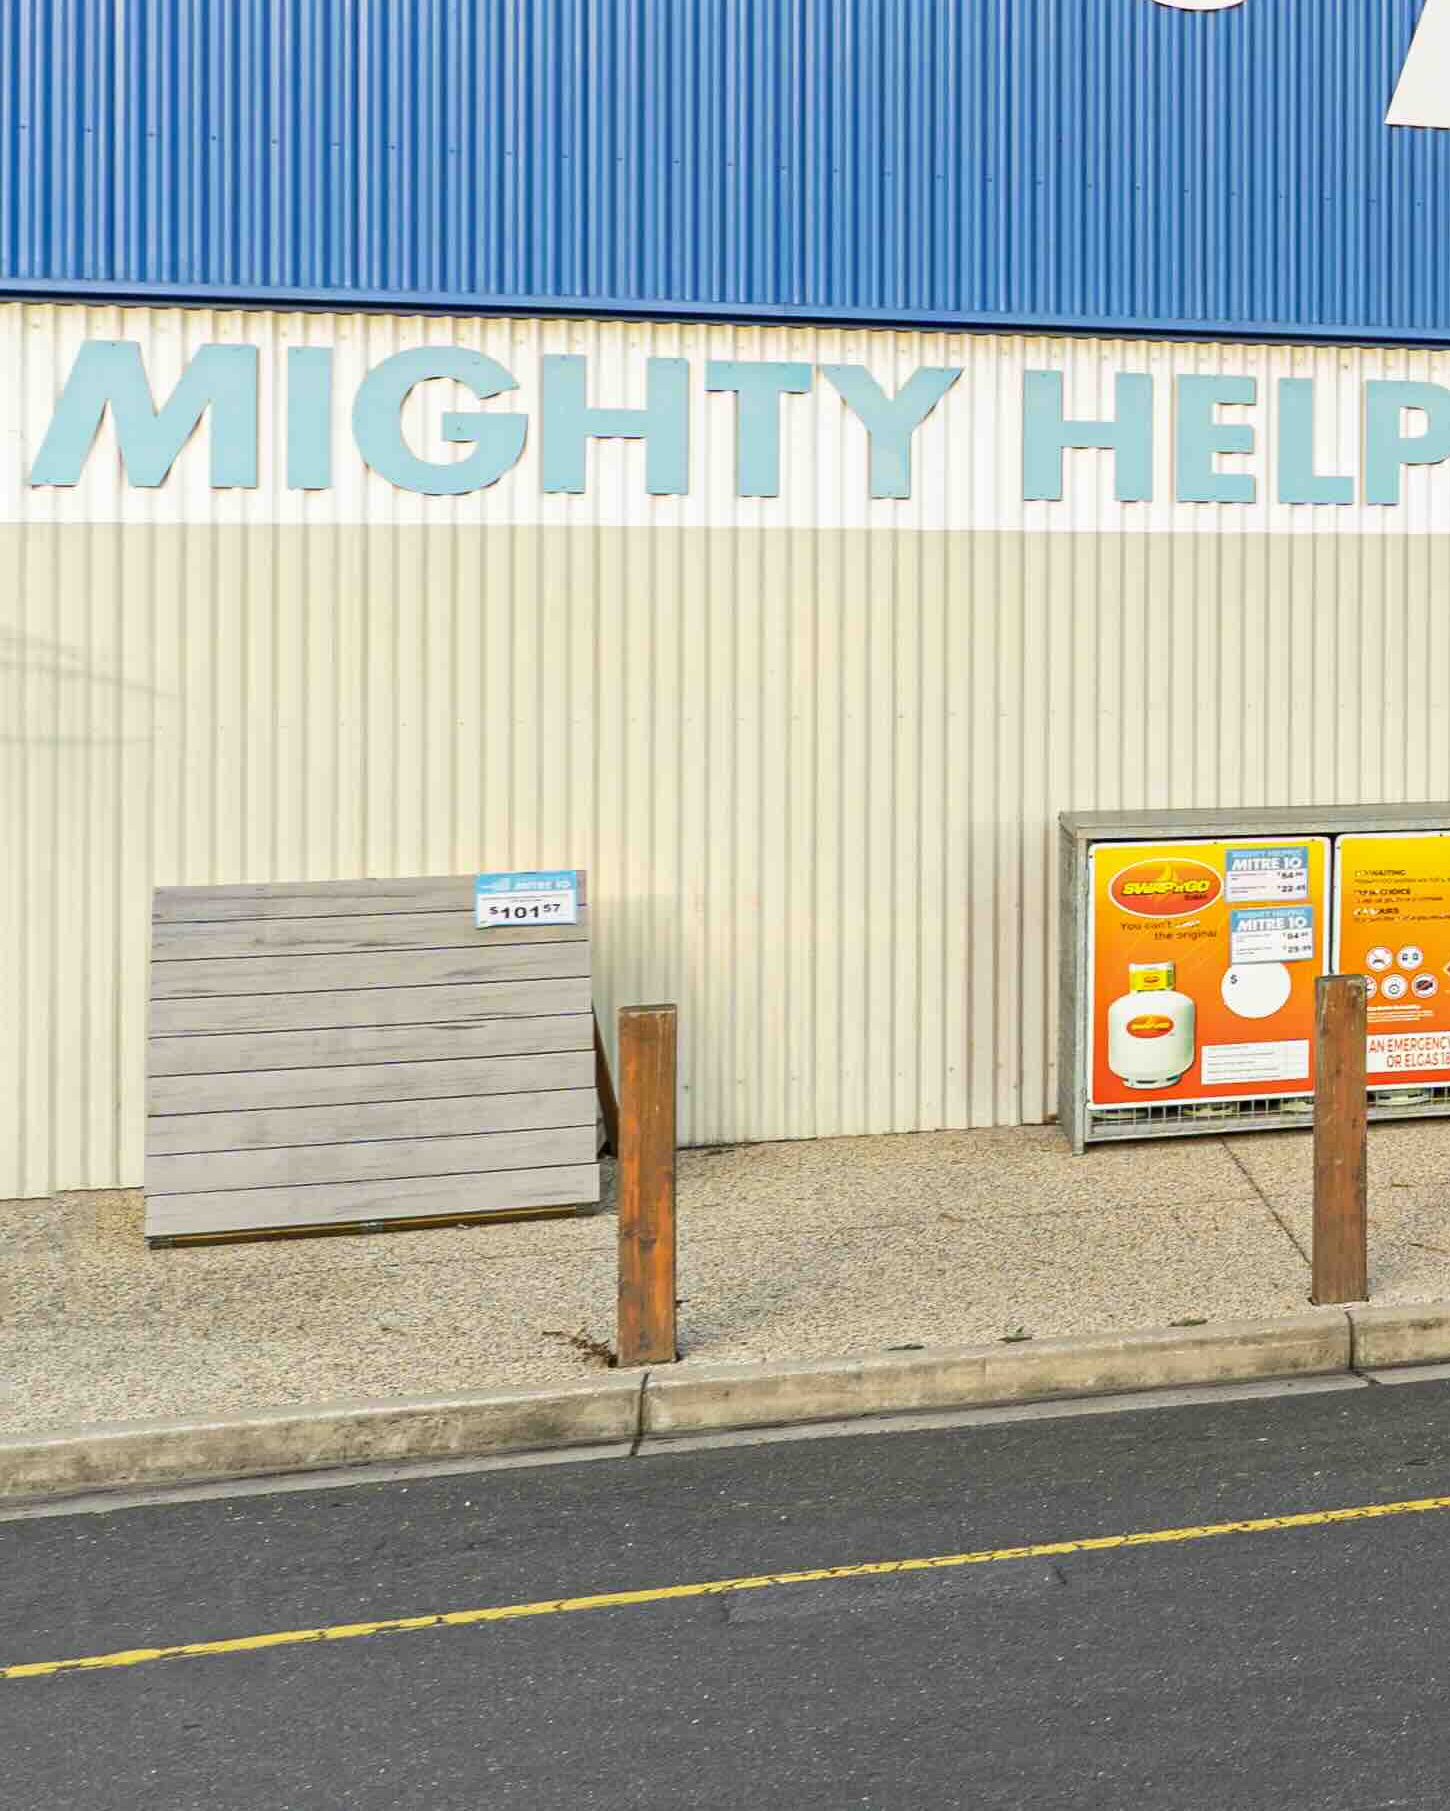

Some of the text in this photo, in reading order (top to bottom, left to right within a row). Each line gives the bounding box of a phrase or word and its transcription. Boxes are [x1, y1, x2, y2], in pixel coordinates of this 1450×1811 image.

[30, 340, 961, 497] MIGHTY
[1231, 857, 1302, 871] MITRE 10
[1120, 922, 1142, 931] You
[1238, 917, 1308, 932] MITRE 10
[1154, 932, 1173, 940] the
[1230, 974, 1238, 984] $
[1369, 1040, 1385, 1053] AN
[1386, 1055, 1402, 1068] OR
[1404, 1053, 1439, 1067] ELGAS
